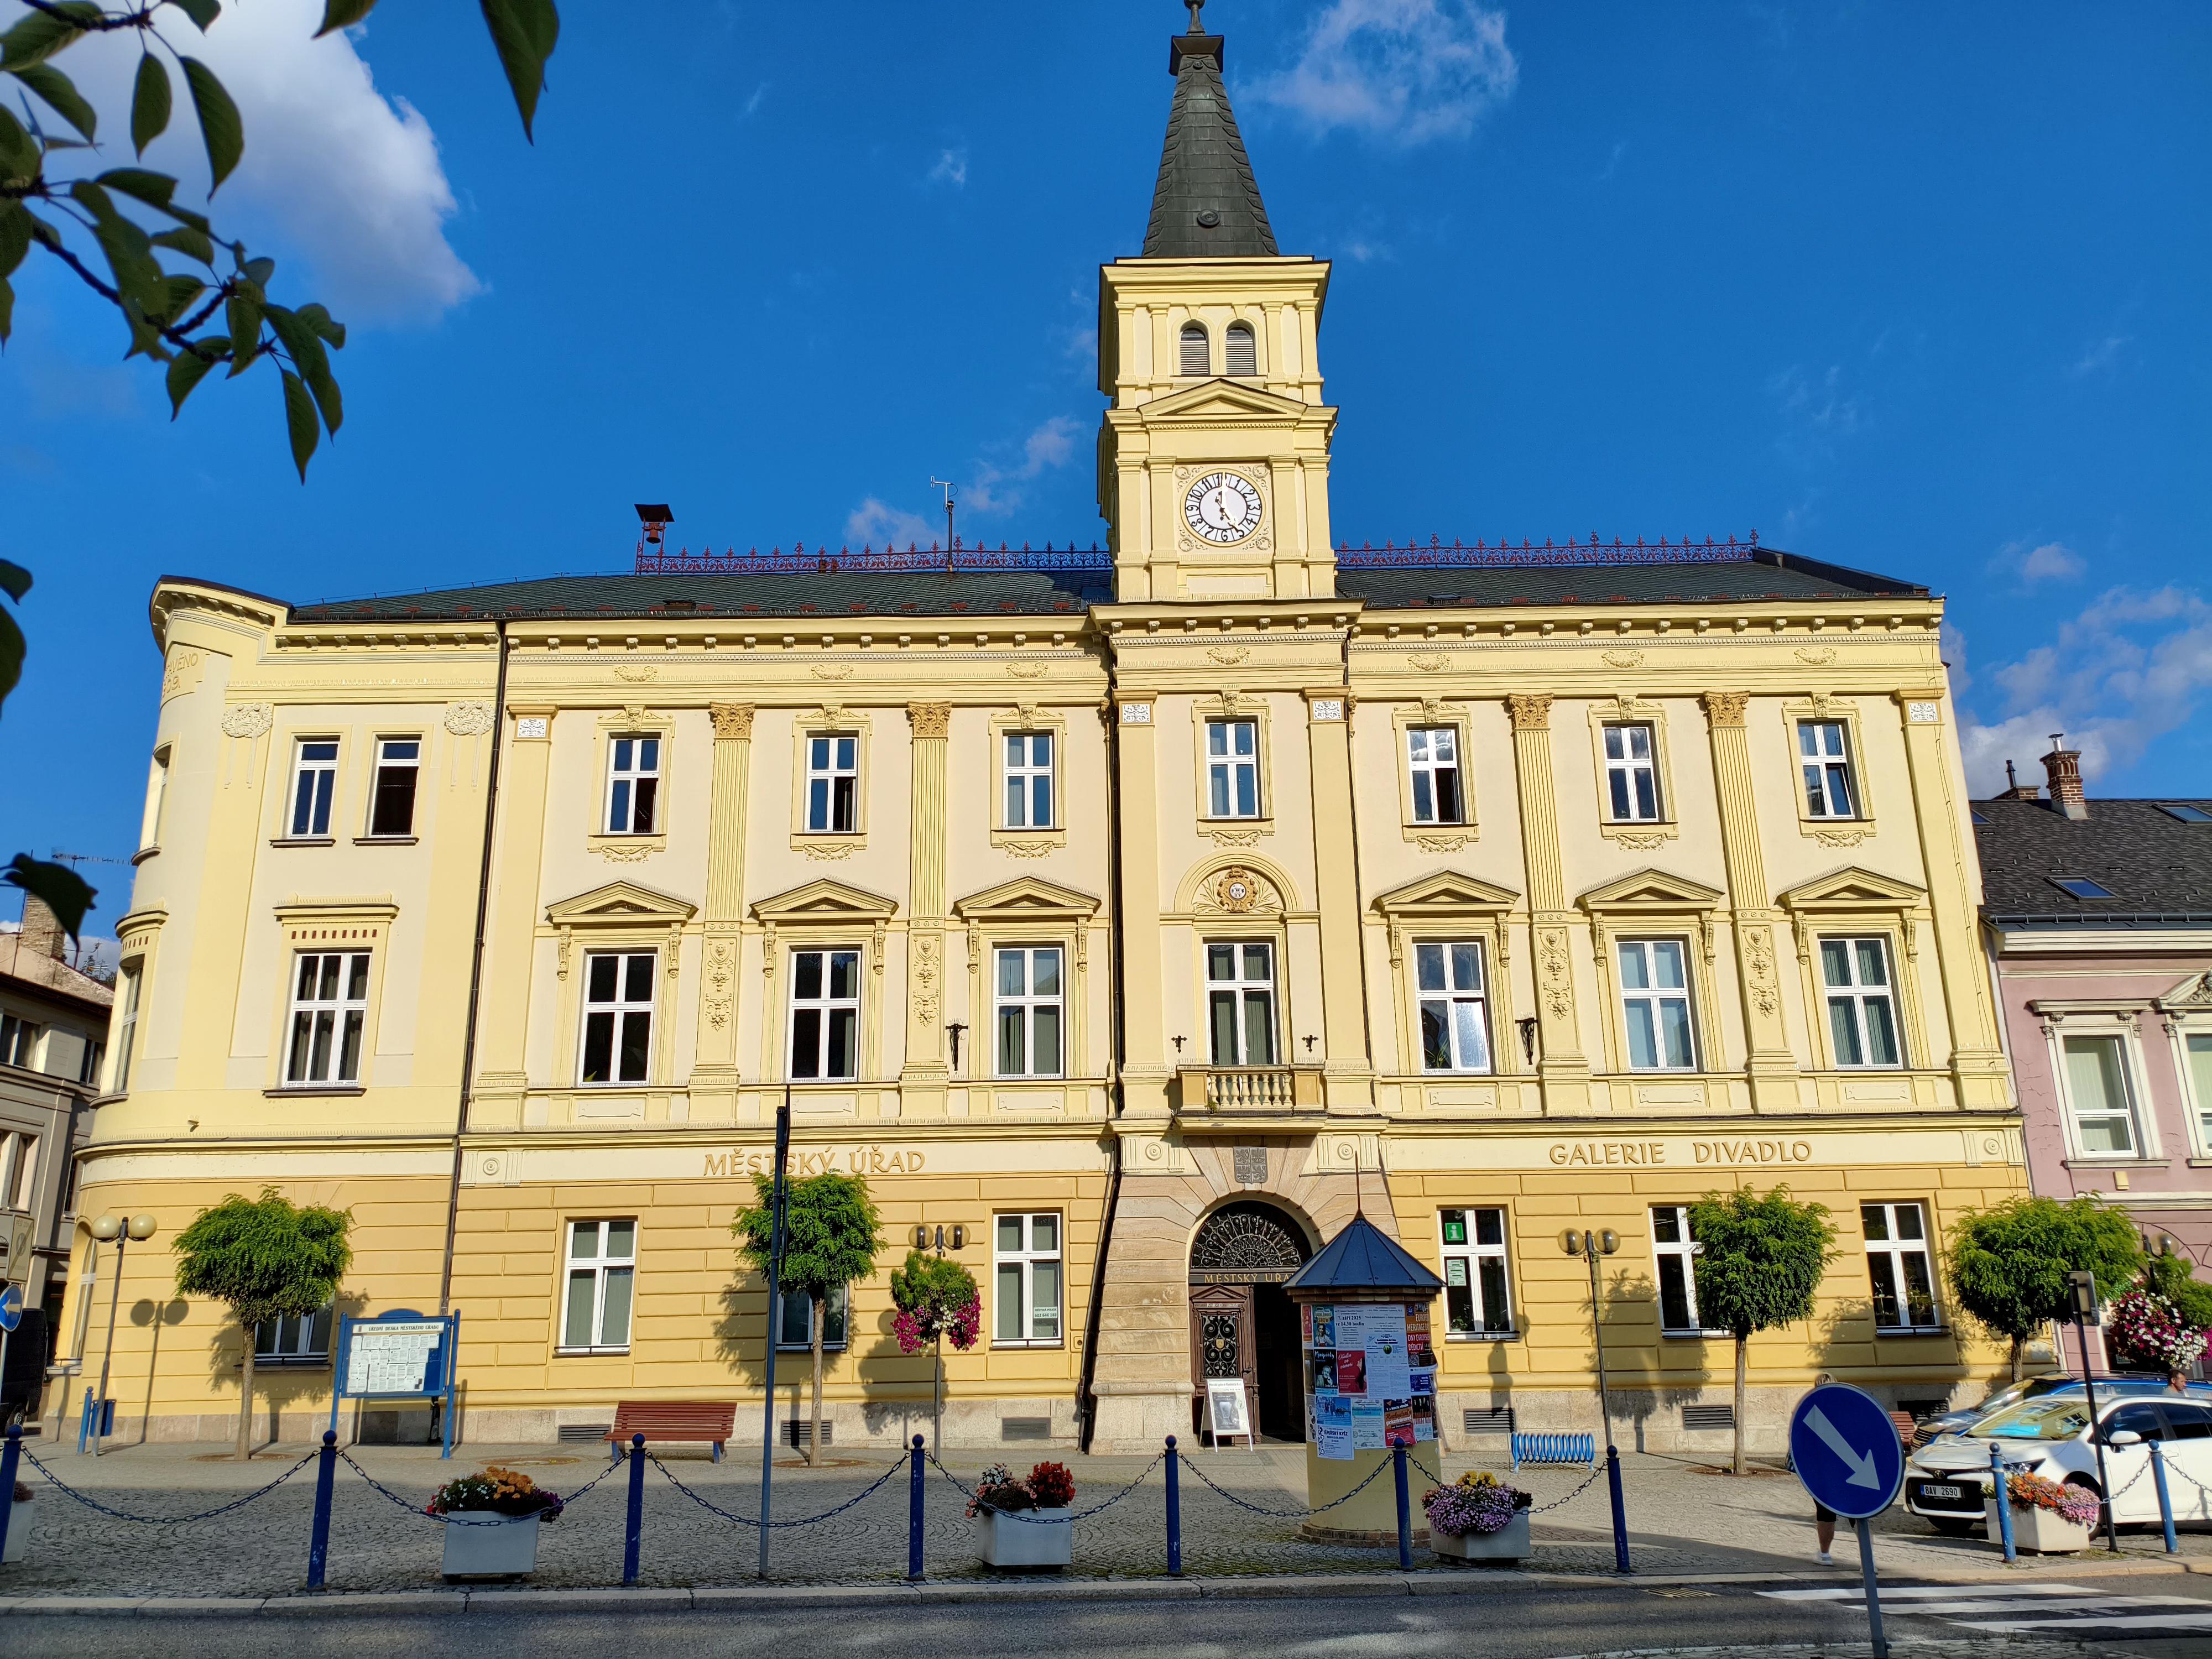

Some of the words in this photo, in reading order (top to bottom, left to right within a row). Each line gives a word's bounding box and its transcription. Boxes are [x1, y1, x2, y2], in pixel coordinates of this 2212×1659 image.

[703, 1146, 836, 1176] MĚSTSKÝ
[849, 1145, 926, 1173] ÚŘAD
[1549, 1142, 1666, 1165] GALERIE
[1693, 1140, 1813, 1162] DIVADLO
[1265, 1272, 1294, 1282] ÚŘA
[1925, 1486, 1937, 1495] 8AV
[1941, 1486, 1958, 1496] 2690
